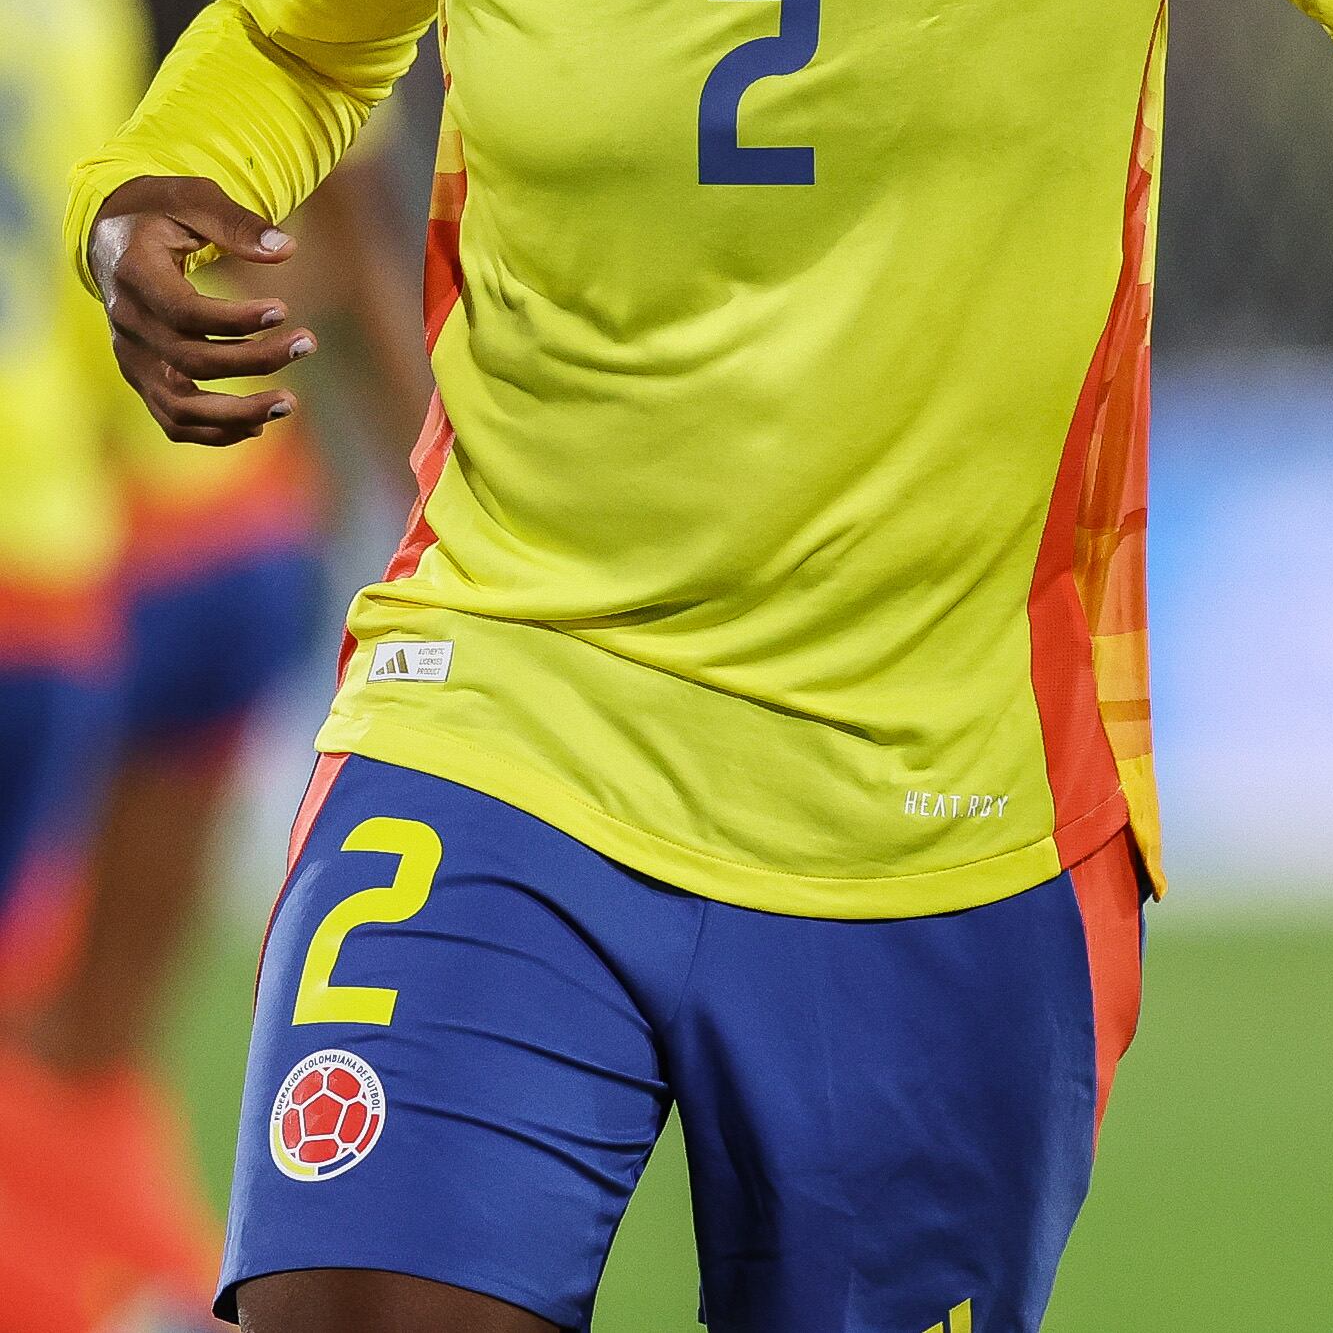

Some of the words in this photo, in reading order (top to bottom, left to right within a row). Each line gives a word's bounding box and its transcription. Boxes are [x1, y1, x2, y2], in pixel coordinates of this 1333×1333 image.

[904, 790, 1009, 818] HEAT.RDY
[291, 816, 443, 1026] 2
[303, 1054, 357, 1071] COLOMBIANA
[355, 1066, 369, 1078] DE
